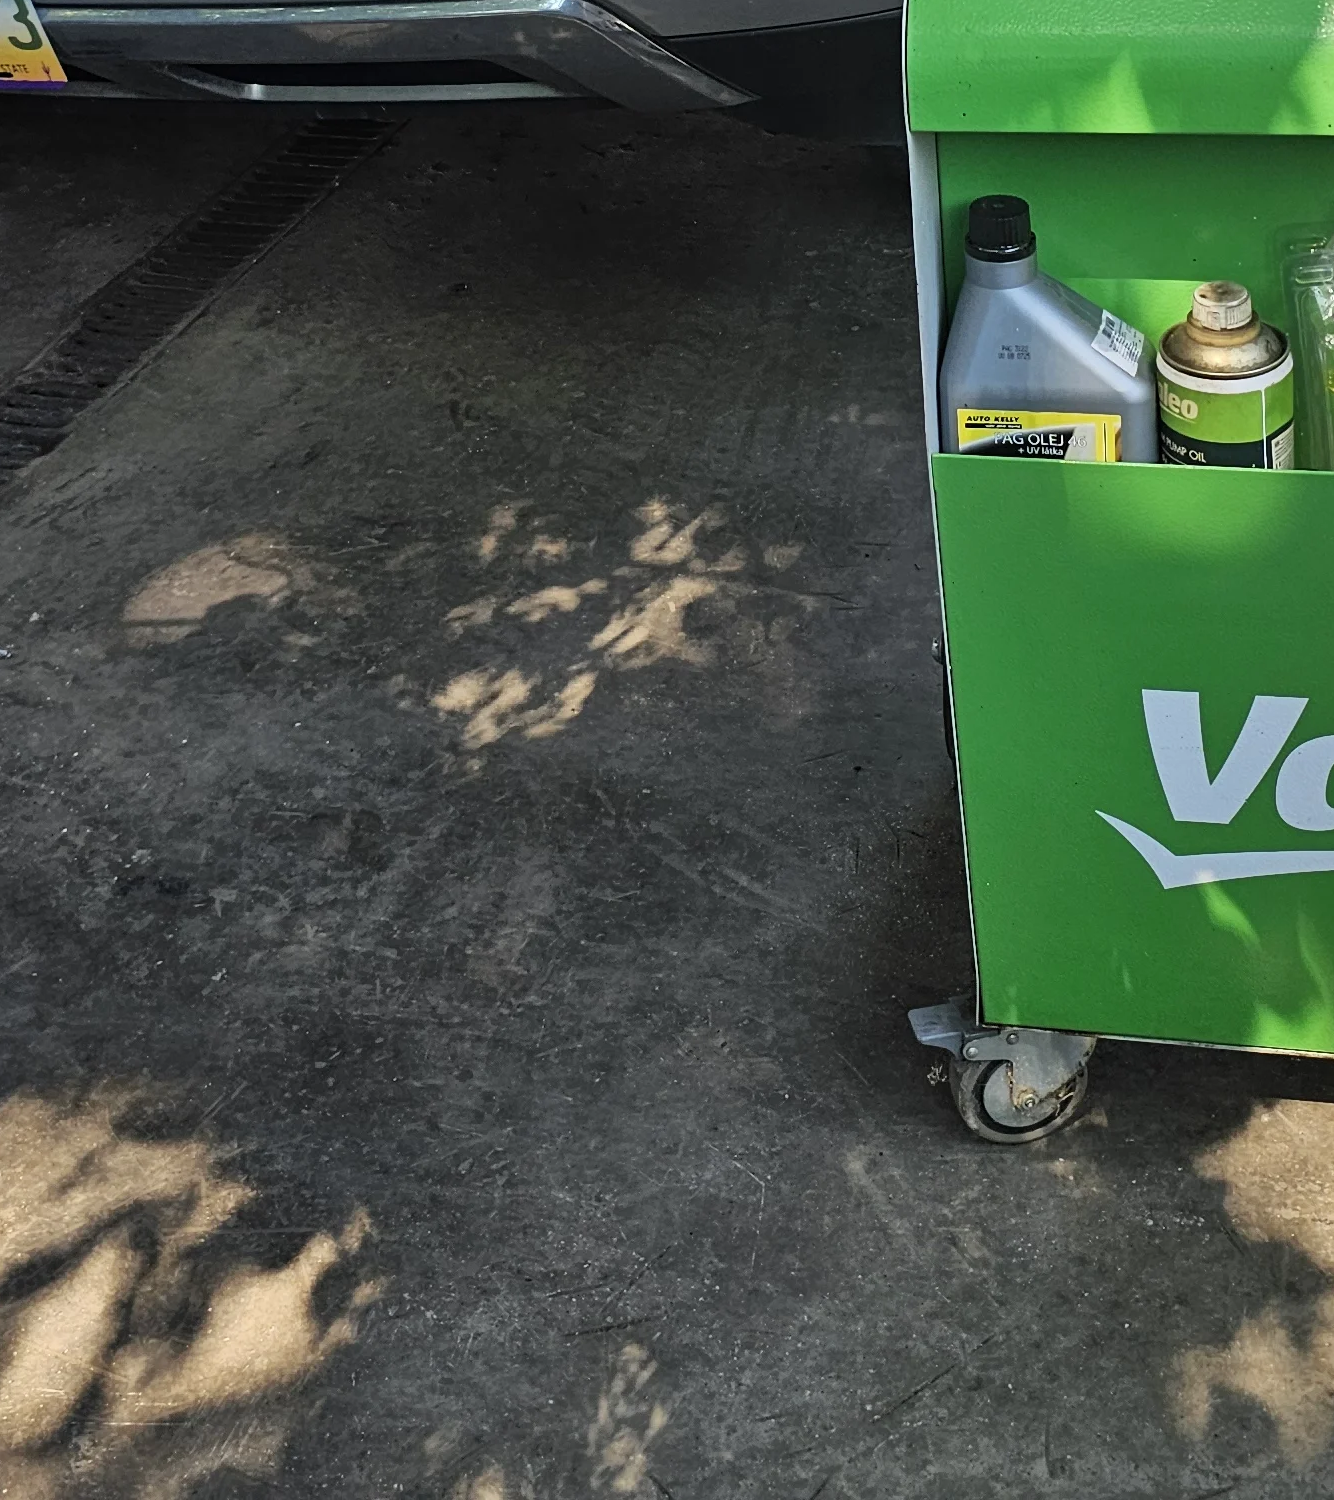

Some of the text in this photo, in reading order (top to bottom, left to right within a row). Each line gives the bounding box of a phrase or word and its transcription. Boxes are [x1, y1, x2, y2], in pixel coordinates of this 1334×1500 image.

[0, 64, 29, 74] STATE
[1158, 381, 1198, 419] leo
[994, 432, 1088, 447] PAG OLEJ 46
[1027, 446, 1040, 455] UV
[1189, 449, 1207, 464] OIL
